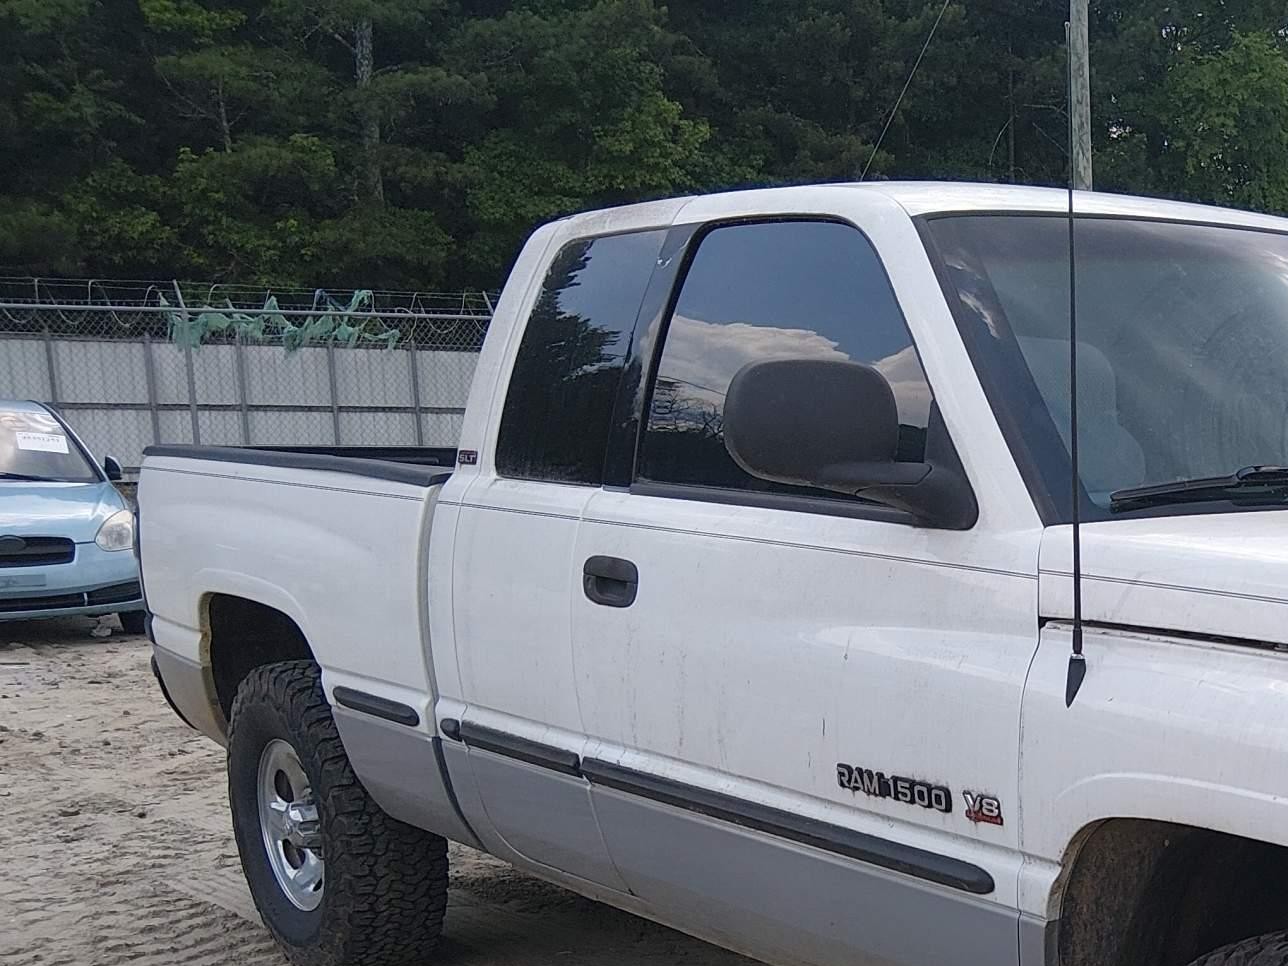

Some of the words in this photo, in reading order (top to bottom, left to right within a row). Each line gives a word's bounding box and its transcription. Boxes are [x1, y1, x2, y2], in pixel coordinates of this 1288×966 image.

[458, 453, 477, 463] SLT
[837, 764, 882, 797] RAM
[886, 775, 951, 813] 1500
[963, 791, 1000, 817] V8
